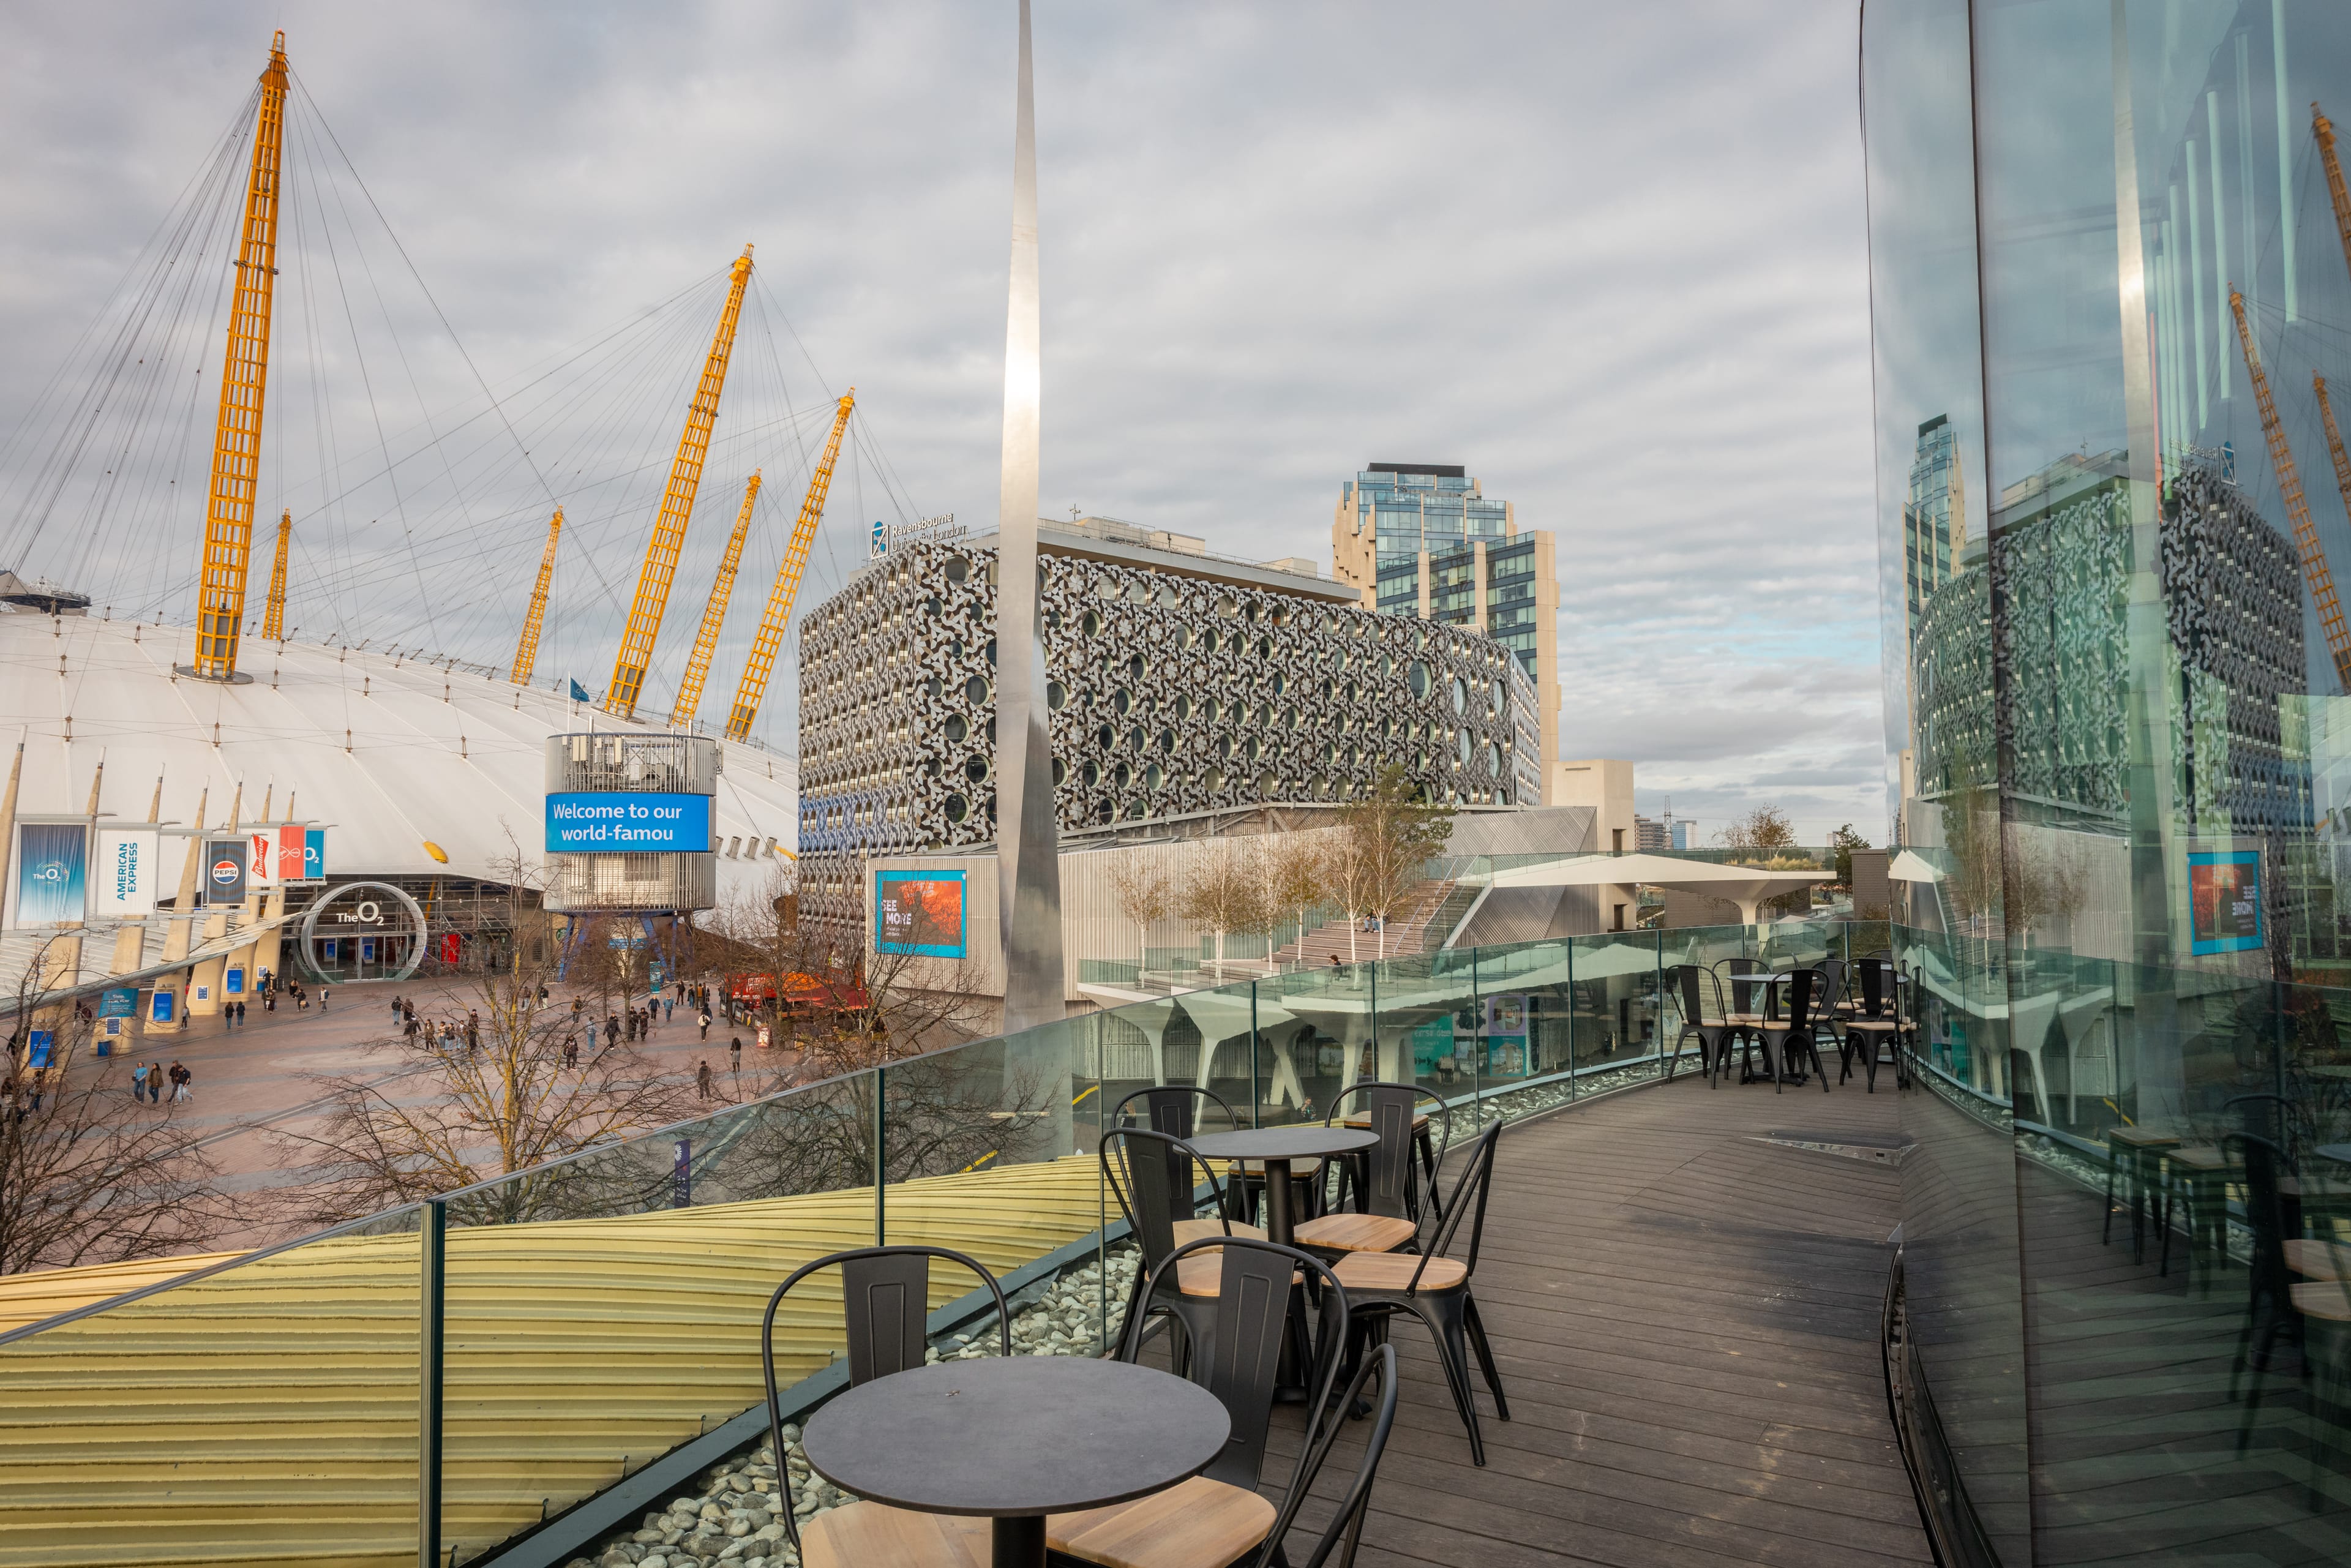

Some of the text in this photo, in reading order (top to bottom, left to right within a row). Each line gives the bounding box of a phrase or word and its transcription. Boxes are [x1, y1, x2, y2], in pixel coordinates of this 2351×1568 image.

[893, 513, 953, 537] Ravensbourne
[933, 523, 967, 542] London
[553, 803, 683, 819] Welcome to our
[561, 824, 673, 841] world-famou
[127, 842, 138, 892] EXPRESS
[255, 836, 264, 877] Budweiser
[117, 843, 127, 901] AMERICAN
[336, 901, 384, 926] The O2
[882, 899, 897, 912] SEE
[886, 912, 912, 925] MORE
